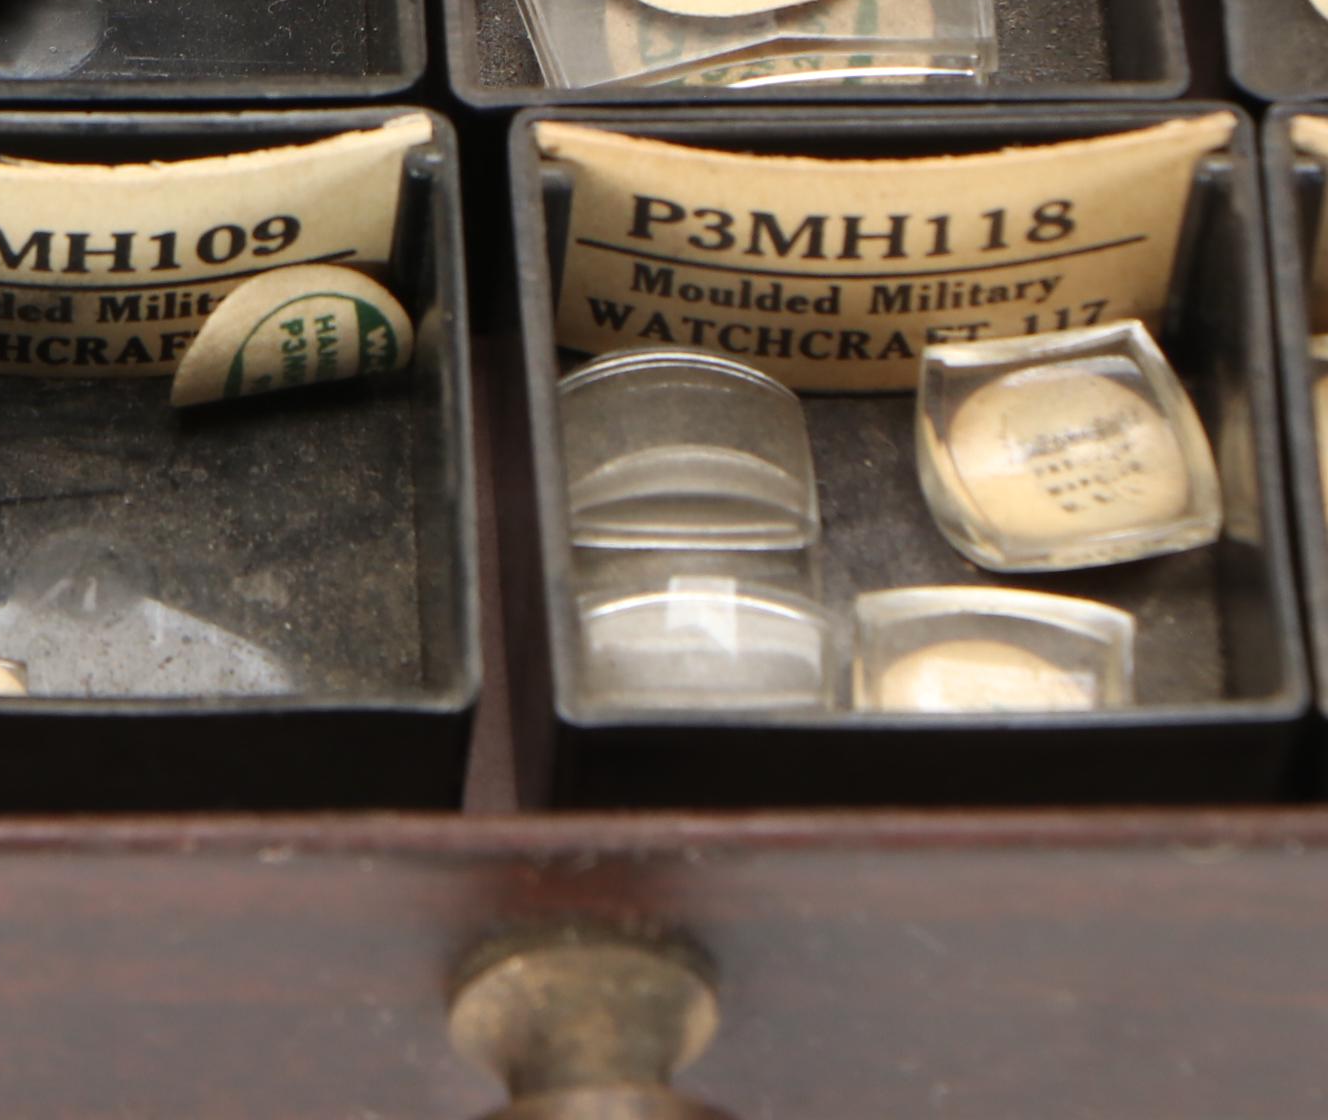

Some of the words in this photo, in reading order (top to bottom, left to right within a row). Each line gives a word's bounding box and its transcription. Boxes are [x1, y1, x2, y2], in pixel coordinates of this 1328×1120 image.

[626, 194, 1077, 259] P3MH118
[95, 291, 227, 324] Milit
[630, 263, 841, 315] Moulded
[868, 275, 1064, 315] Military
[1023, 299, 1109, 336] 117
